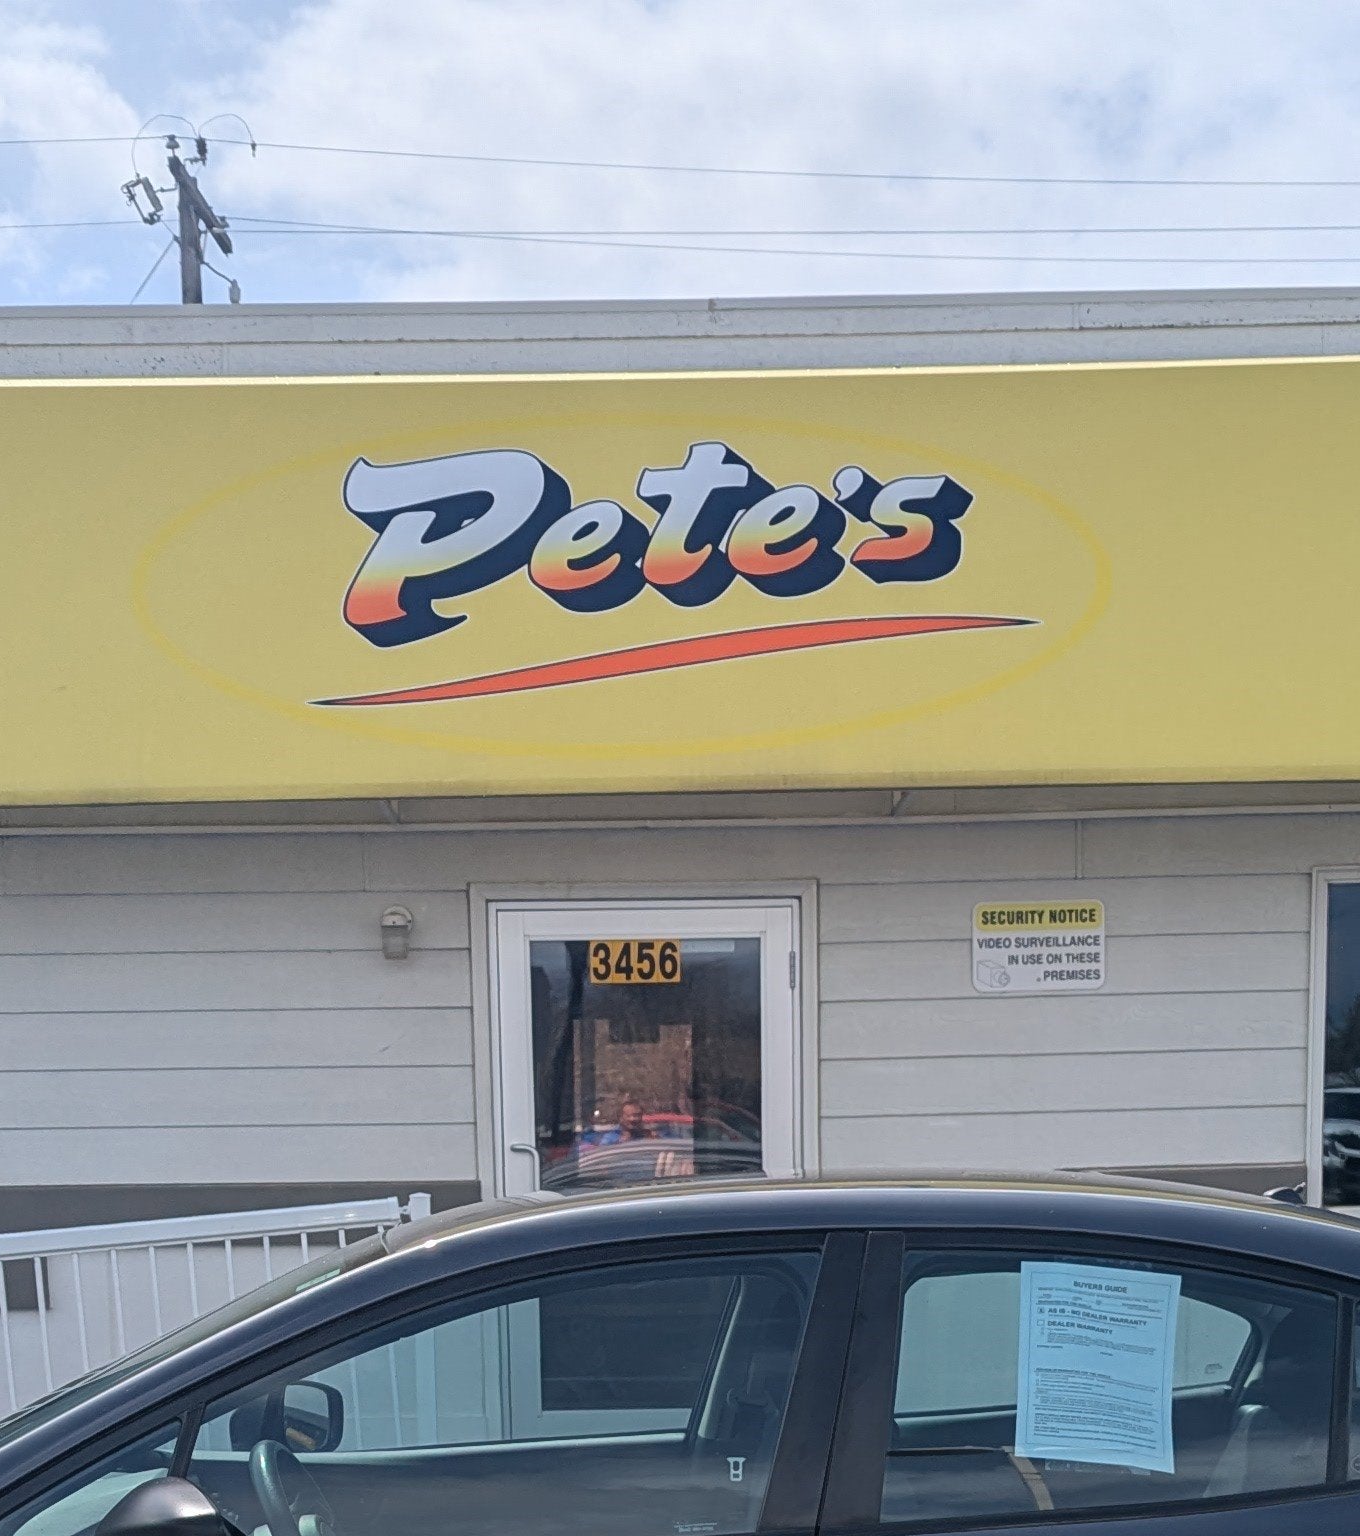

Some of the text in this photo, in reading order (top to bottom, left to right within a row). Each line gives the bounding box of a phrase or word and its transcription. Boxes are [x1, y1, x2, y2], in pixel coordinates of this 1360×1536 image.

[343, 441, 974, 648] Pete's
[981, 908, 1096, 926] SECURITY NOTICE
[977, 934, 1101, 949] VIDEO SURVEILLANCE
[592, 941, 678, 981] 3456
[1007, 952, 1101, 965] IN USE ON THESE
[1043, 969, 1101, 981] PREMISES
[1073, 1280, 1128, 1294] BUYERS GUIDE
[1082, 1311, 1108, 1321] DEALER
[1109, 1316, 1148, 1326] WARRANTY
[1047, 1320, 1113, 1335] DEALER WARRANTY
